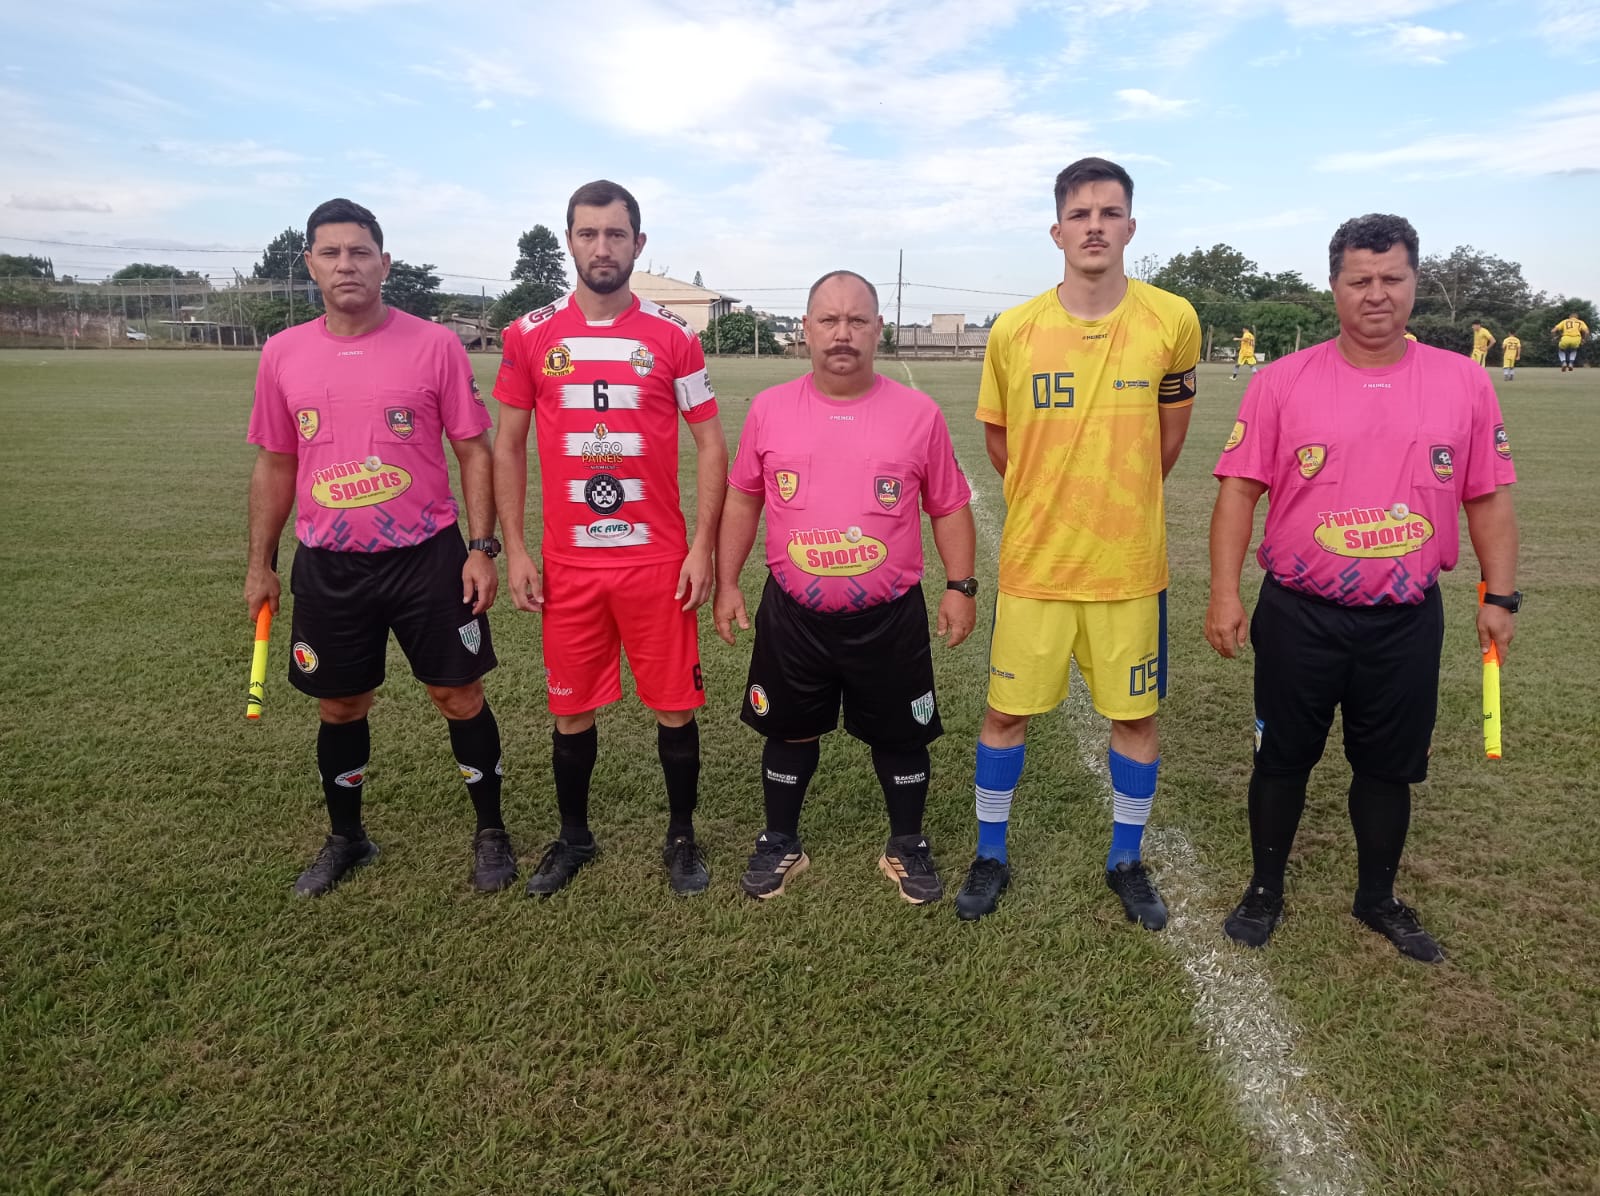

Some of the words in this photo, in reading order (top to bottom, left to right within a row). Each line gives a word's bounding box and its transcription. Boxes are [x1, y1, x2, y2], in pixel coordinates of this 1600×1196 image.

[593, 379, 609, 412] 6
[1032, 372, 1074, 408] 05
[582, 441, 623, 454] AGRO
[329, 472, 402, 502] Sports
[590, 525, 603, 533] AC
[604, 524, 629, 533] AVES
[1318, 508, 1387, 529] Twbn
[789, 528, 842, 546] Twbn
[1343, 521, 1425, 550] Sports
[805, 544, 880, 569] Sports
